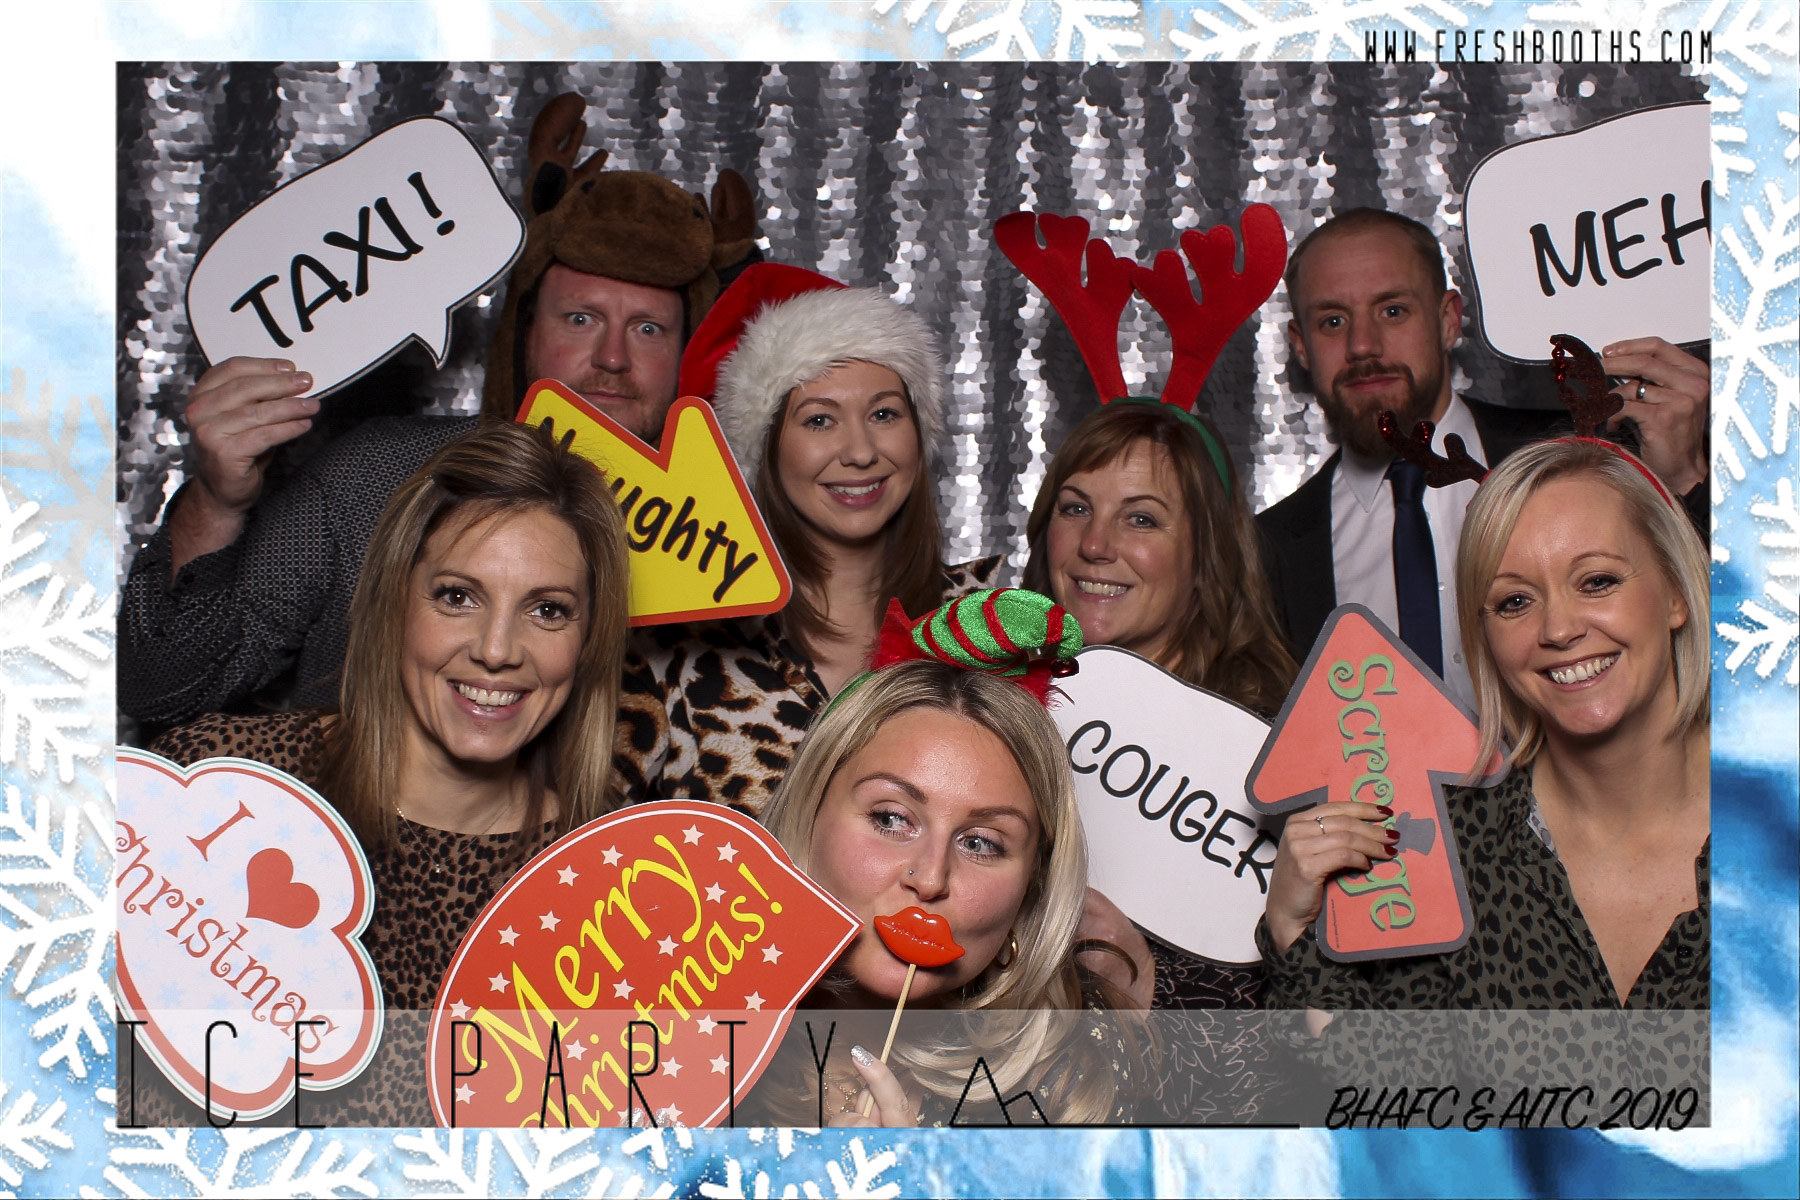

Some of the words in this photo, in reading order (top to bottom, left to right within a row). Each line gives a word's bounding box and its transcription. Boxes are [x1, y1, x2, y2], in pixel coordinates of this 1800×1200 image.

[230, 171, 456, 349] TAXI!
[1529, 179, 1711, 298] MEH
[539, 416, 759, 603] ghty
[186, 800, 256, 863] I
[1067, 719, 1279, 895] COUGER
[1327, 653, 1417, 932] Scroge
[461, 834, 703, 1104] Merry
